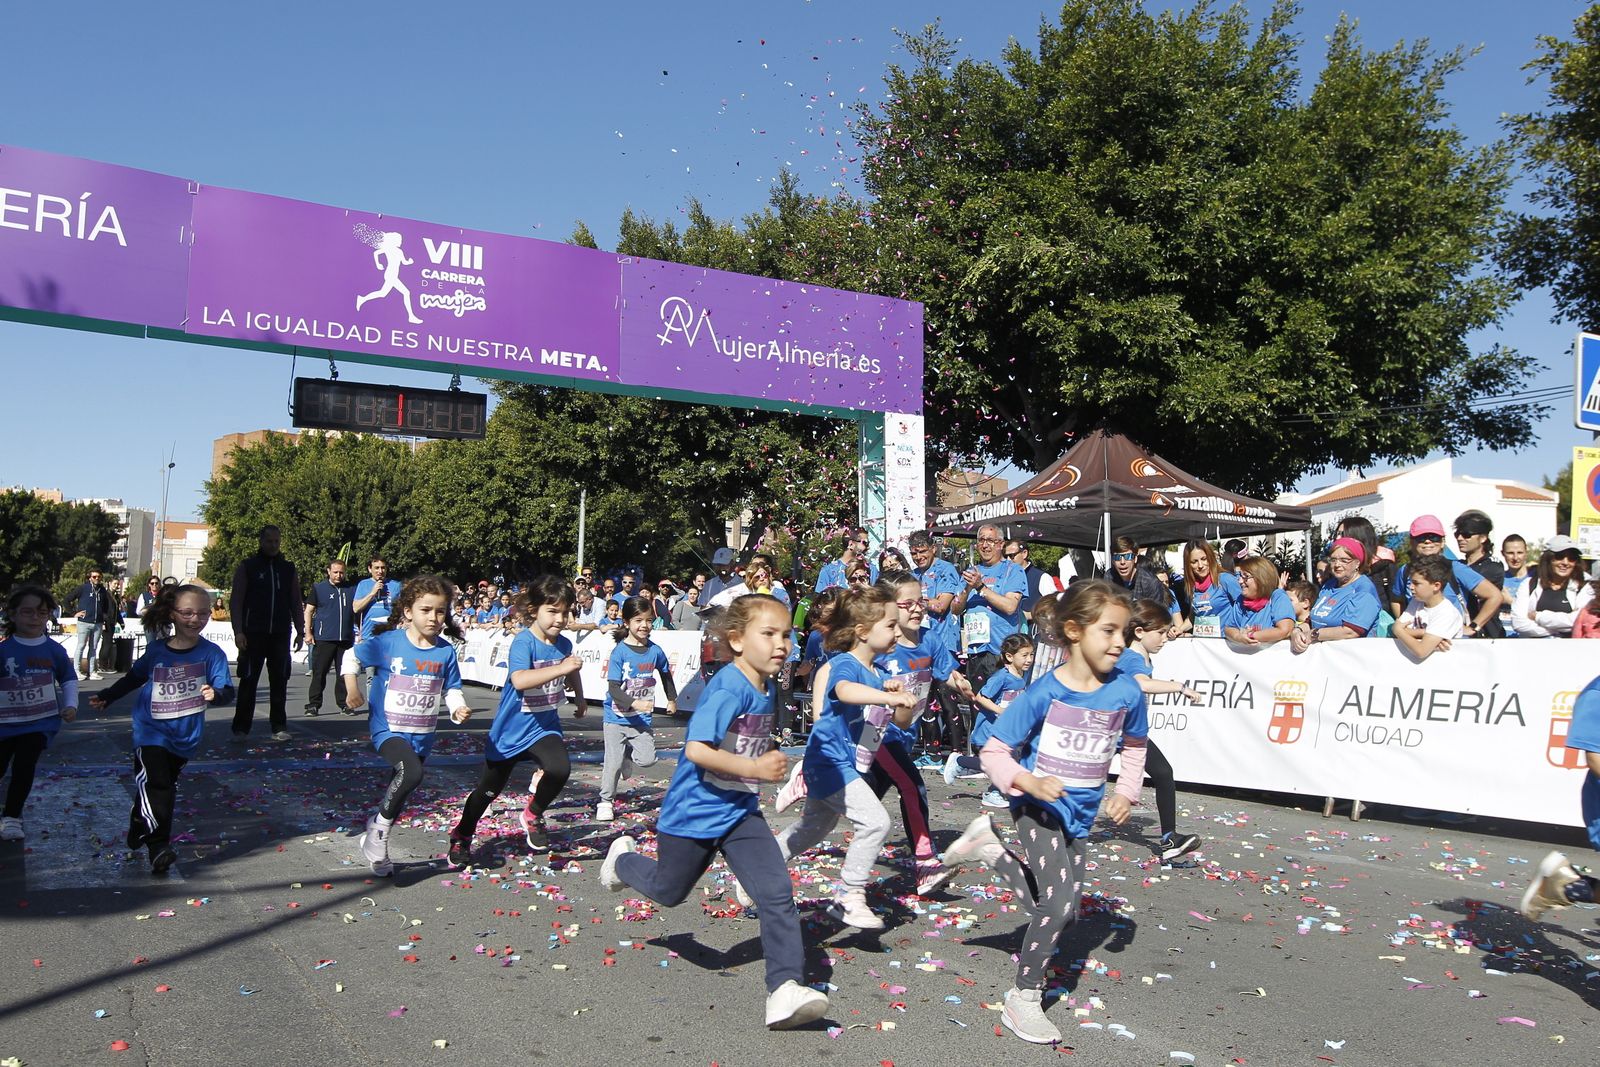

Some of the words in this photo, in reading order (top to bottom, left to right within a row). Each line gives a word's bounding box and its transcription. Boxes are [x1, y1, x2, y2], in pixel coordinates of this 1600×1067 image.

[0, 187, 128, 247] ERÍA
[422, 237, 483, 271] VIII
[421, 268, 486, 287] CARRERA
[421, 279, 444, 290] DE
[464, 286, 486, 296] LA
[420, 289, 487, 318] mujer
[203, 306, 236, 327] LA
[246, 311, 382, 344] IGUALDAD
[391, 330, 419, 348] ES
[427, 335, 534, 363] NUESTRA
[540, 348, 608, 373] META.
[7, 687, 44, 702] 3161
[158, 679, 198, 696] 3095
[396, 692, 436, 709] 3048
[1337, 682, 1527, 728] ALMERÍA
[1056, 729, 1113, 754] 3072
[1333, 721, 1424, 749] CIUDAD
